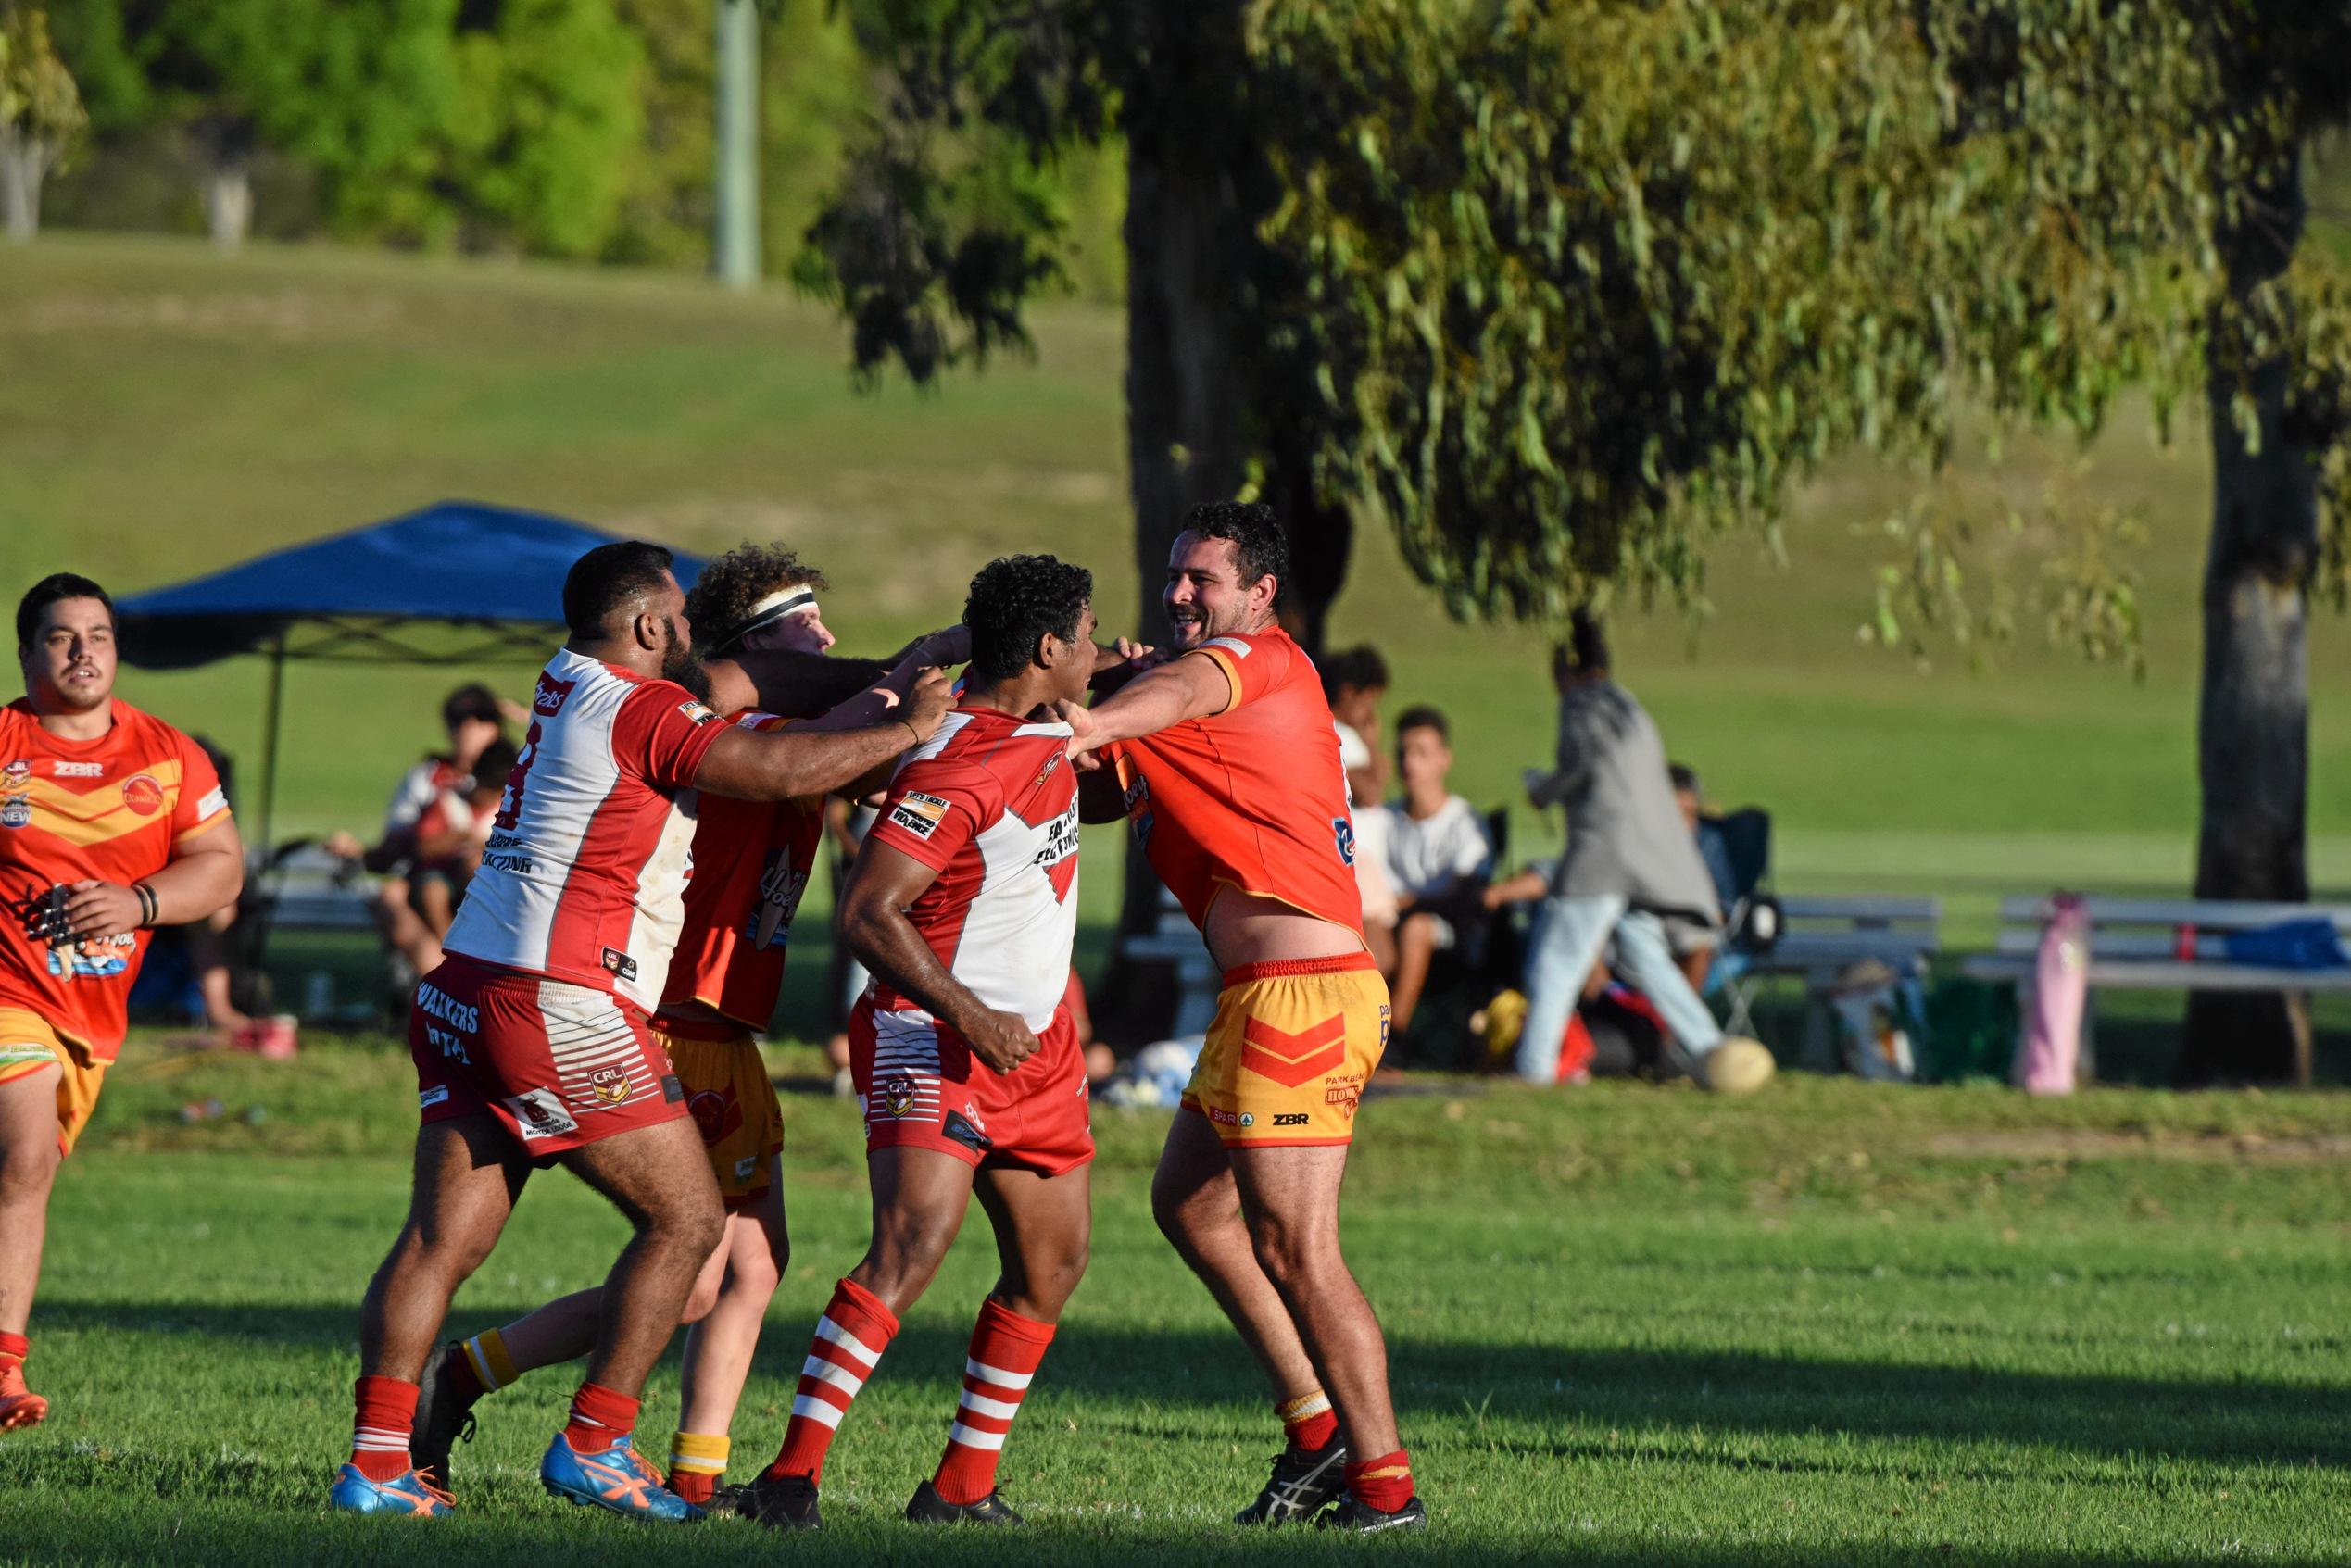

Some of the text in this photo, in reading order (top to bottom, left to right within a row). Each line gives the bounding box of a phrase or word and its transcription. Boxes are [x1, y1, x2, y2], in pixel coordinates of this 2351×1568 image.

[55, 760, 104, 777] ZBR
[909, 791, 948, 808] LET'S TACKLE
[0, 811, 31, 822] NEW
[893, 809, 931, 836] VIOLENCE
[417, 981, 479, 1035] WALKERS
[593, 1068, 623, 1085] CRL
[1326, 1075, 1349, 1085] PARK
[889, 1081, 911, 1094] CRL
[1214, 1110, 1237, 1125] SPAR
[1273, 1113, 1309, 1126] ZBR
